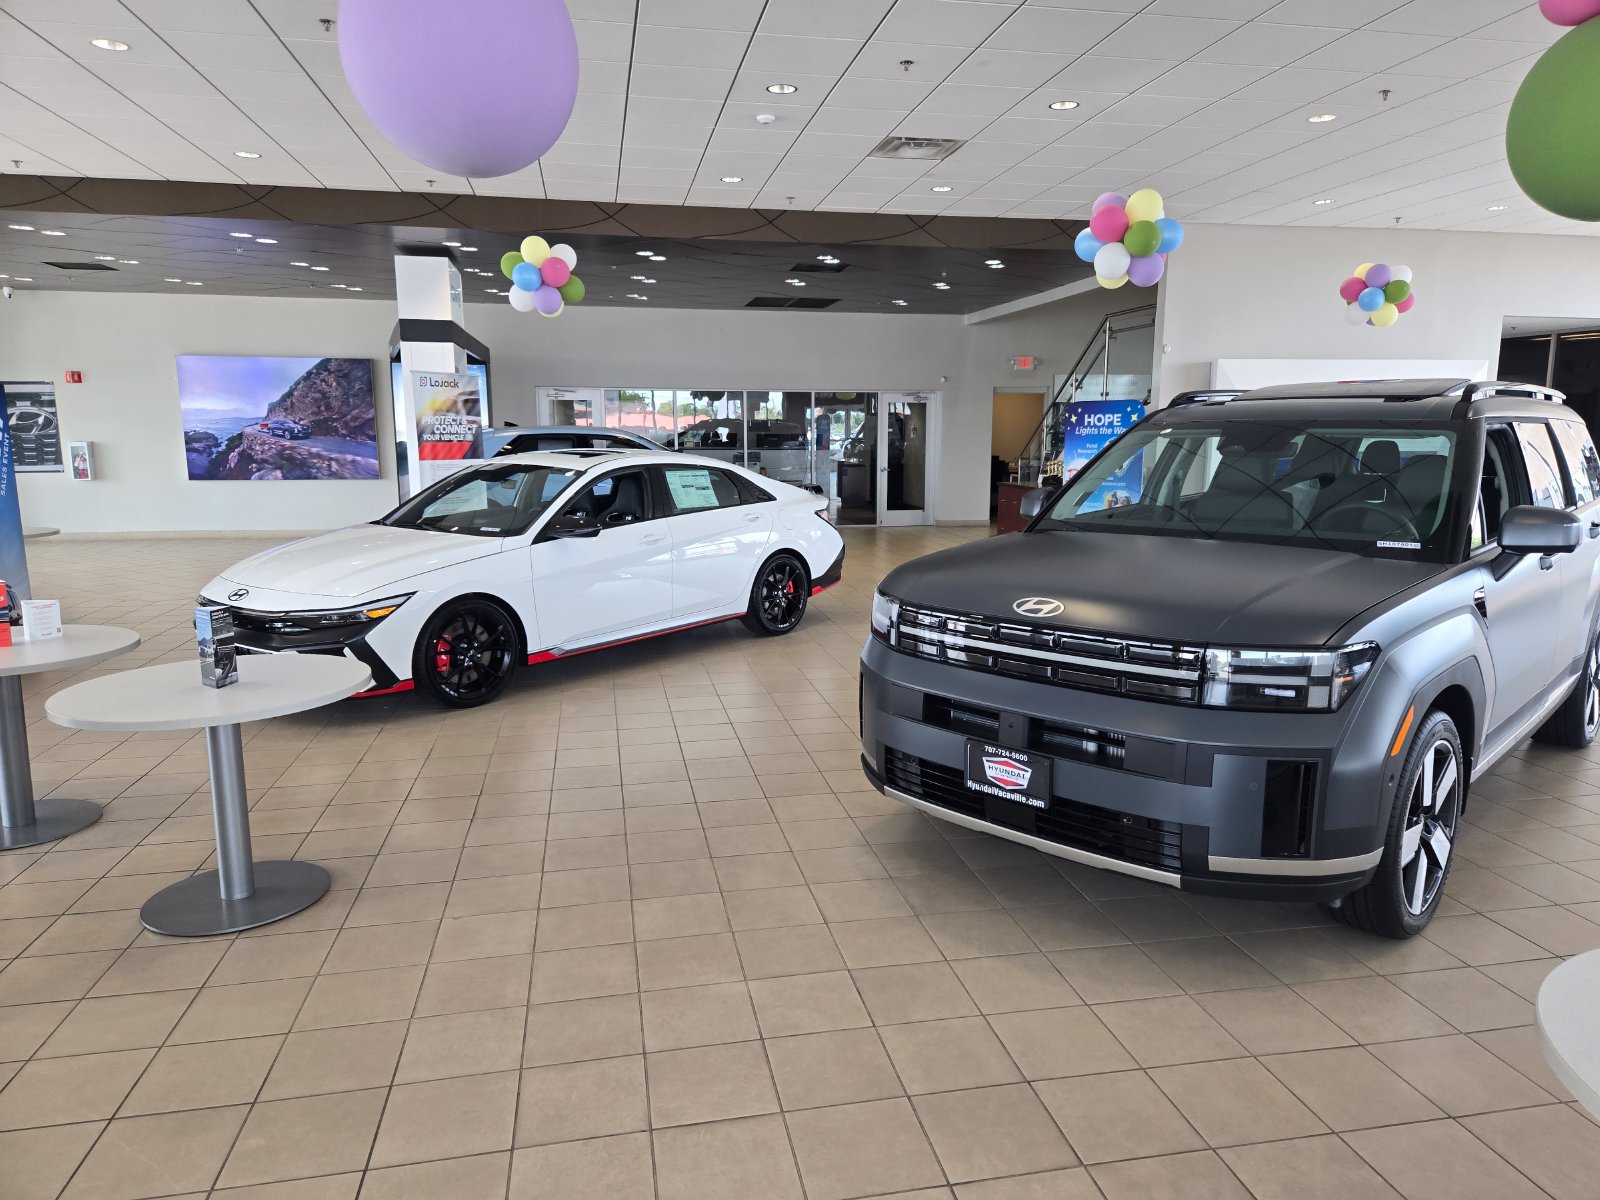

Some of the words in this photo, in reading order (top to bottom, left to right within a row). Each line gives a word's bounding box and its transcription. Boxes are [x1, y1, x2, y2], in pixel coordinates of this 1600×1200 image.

[421, 415, 461, 425] PROTECT
[461, 416, 468, 425] &
[1084, 413, 1122, 426] HOPE
[433, 424, 478, 434] CONNECT
[1075, 426, 1099, 436] Lights
[1099, 426, 1112, 435] the
[422, 433, 440, 441] YOUR
[988, 764, 1026, 780] HYUNDAI
[967, 779, 1045, 808] HyundaiVacaville.com
